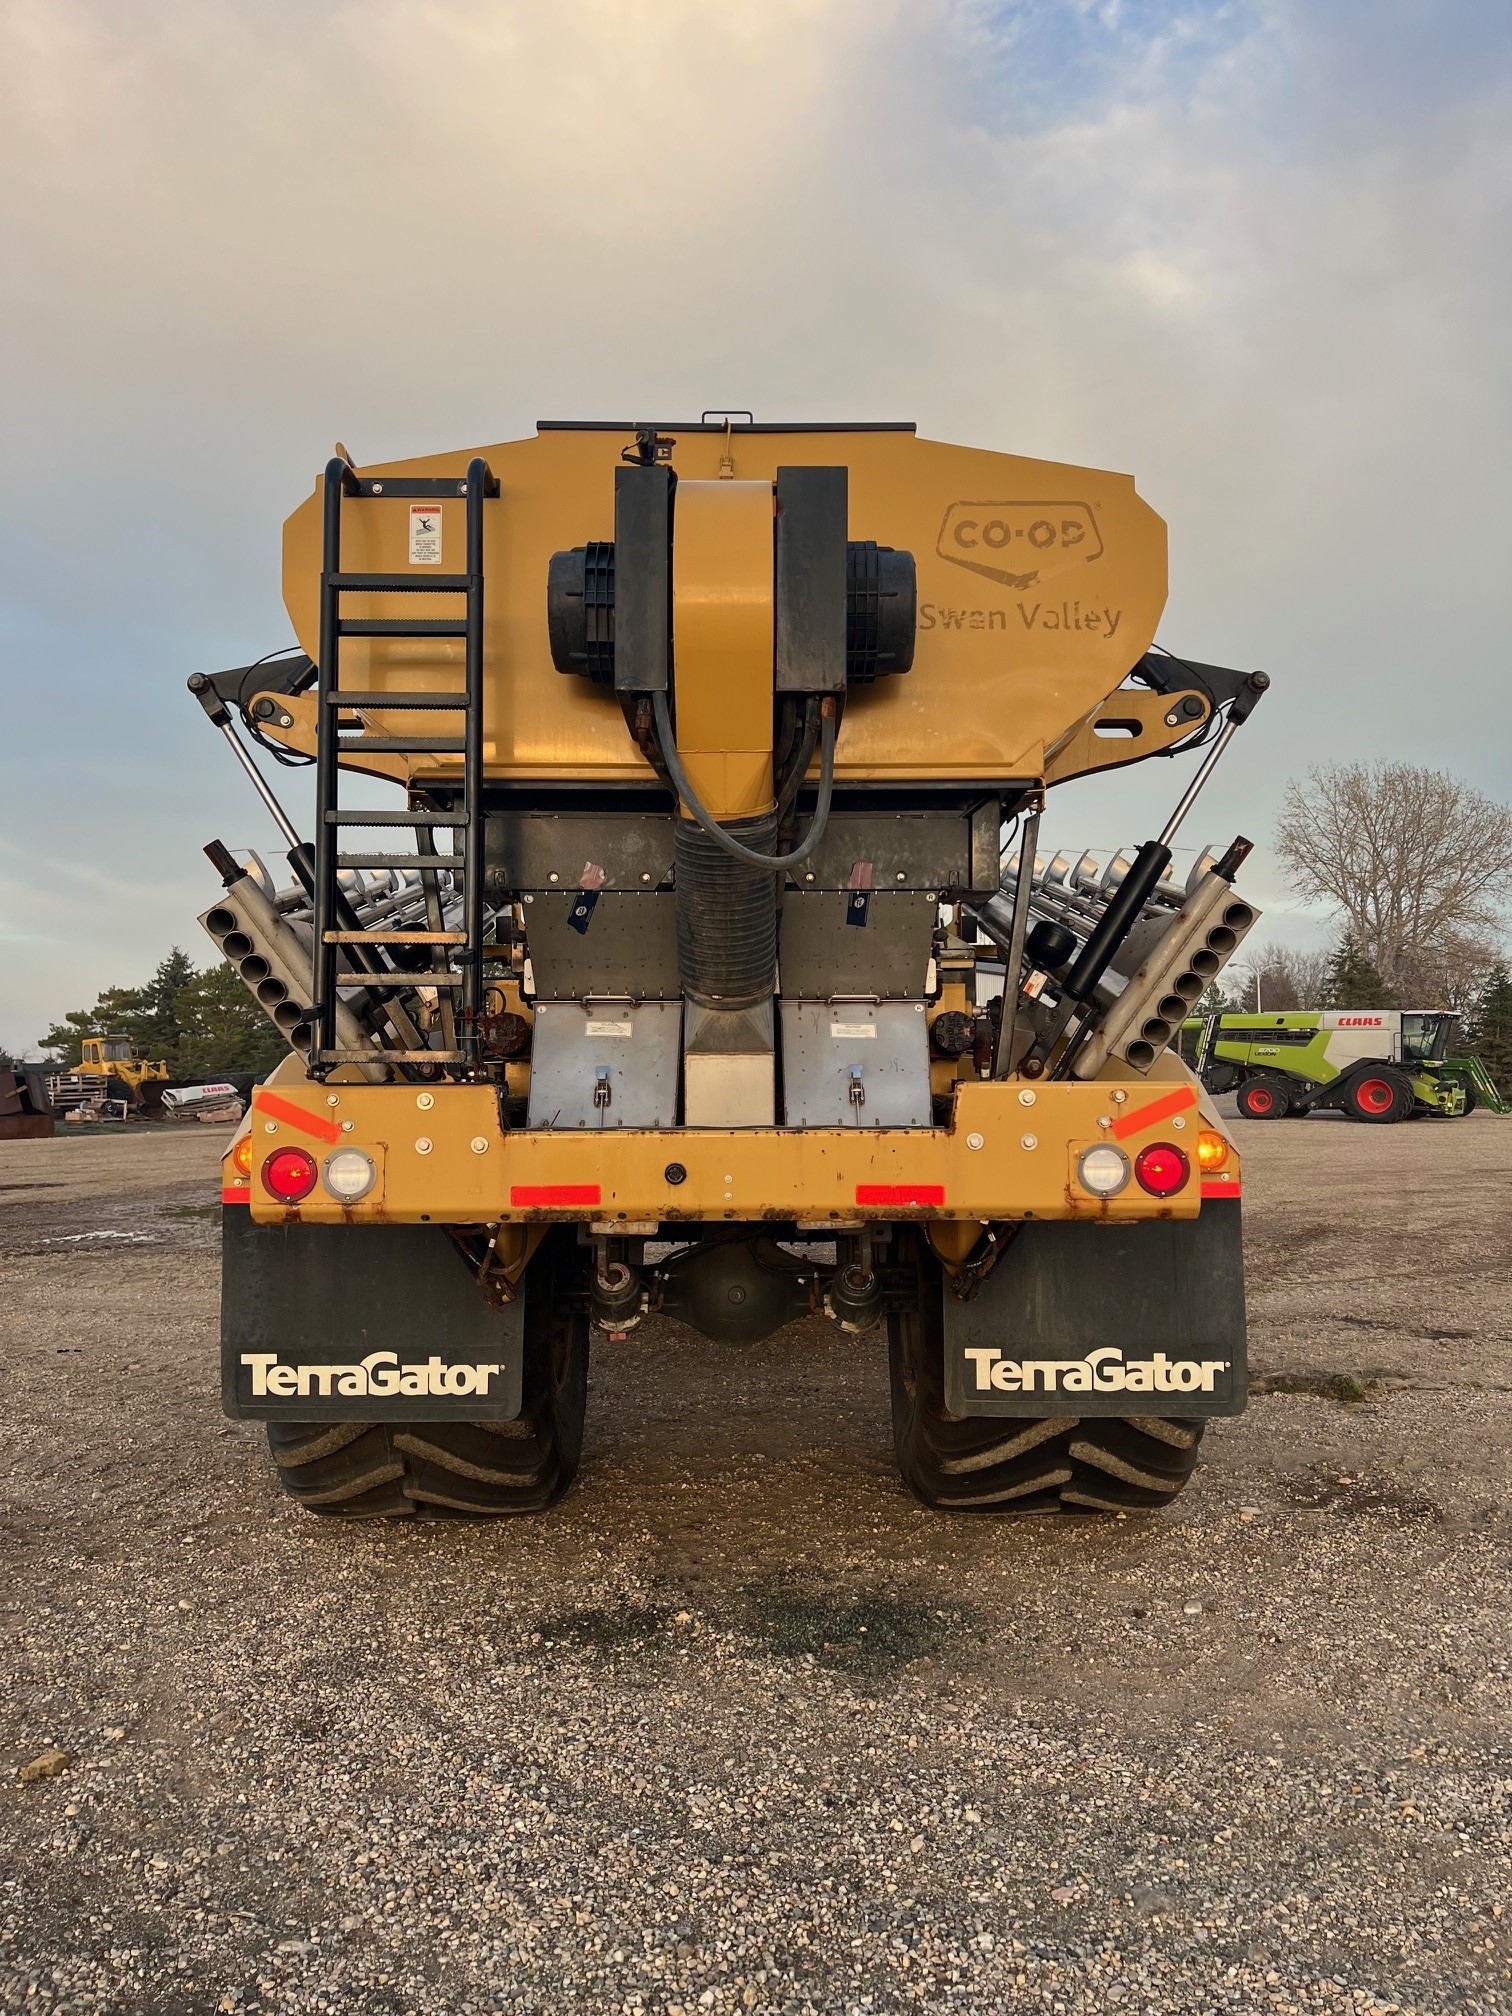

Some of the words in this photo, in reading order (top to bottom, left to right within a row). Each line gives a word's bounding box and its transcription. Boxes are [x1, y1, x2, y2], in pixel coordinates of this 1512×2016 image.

[918, 603, 1007, 631] Swan
[1016, 600, 1123, 639] Valley
[1338, 1017, 1383, 1026] CLAAS
[202, 1085, 230, 1094] CLAAS
[240, 1351, 502, 1396] TerraGator
[964, 1347, 1227, 1392] TerraGator
